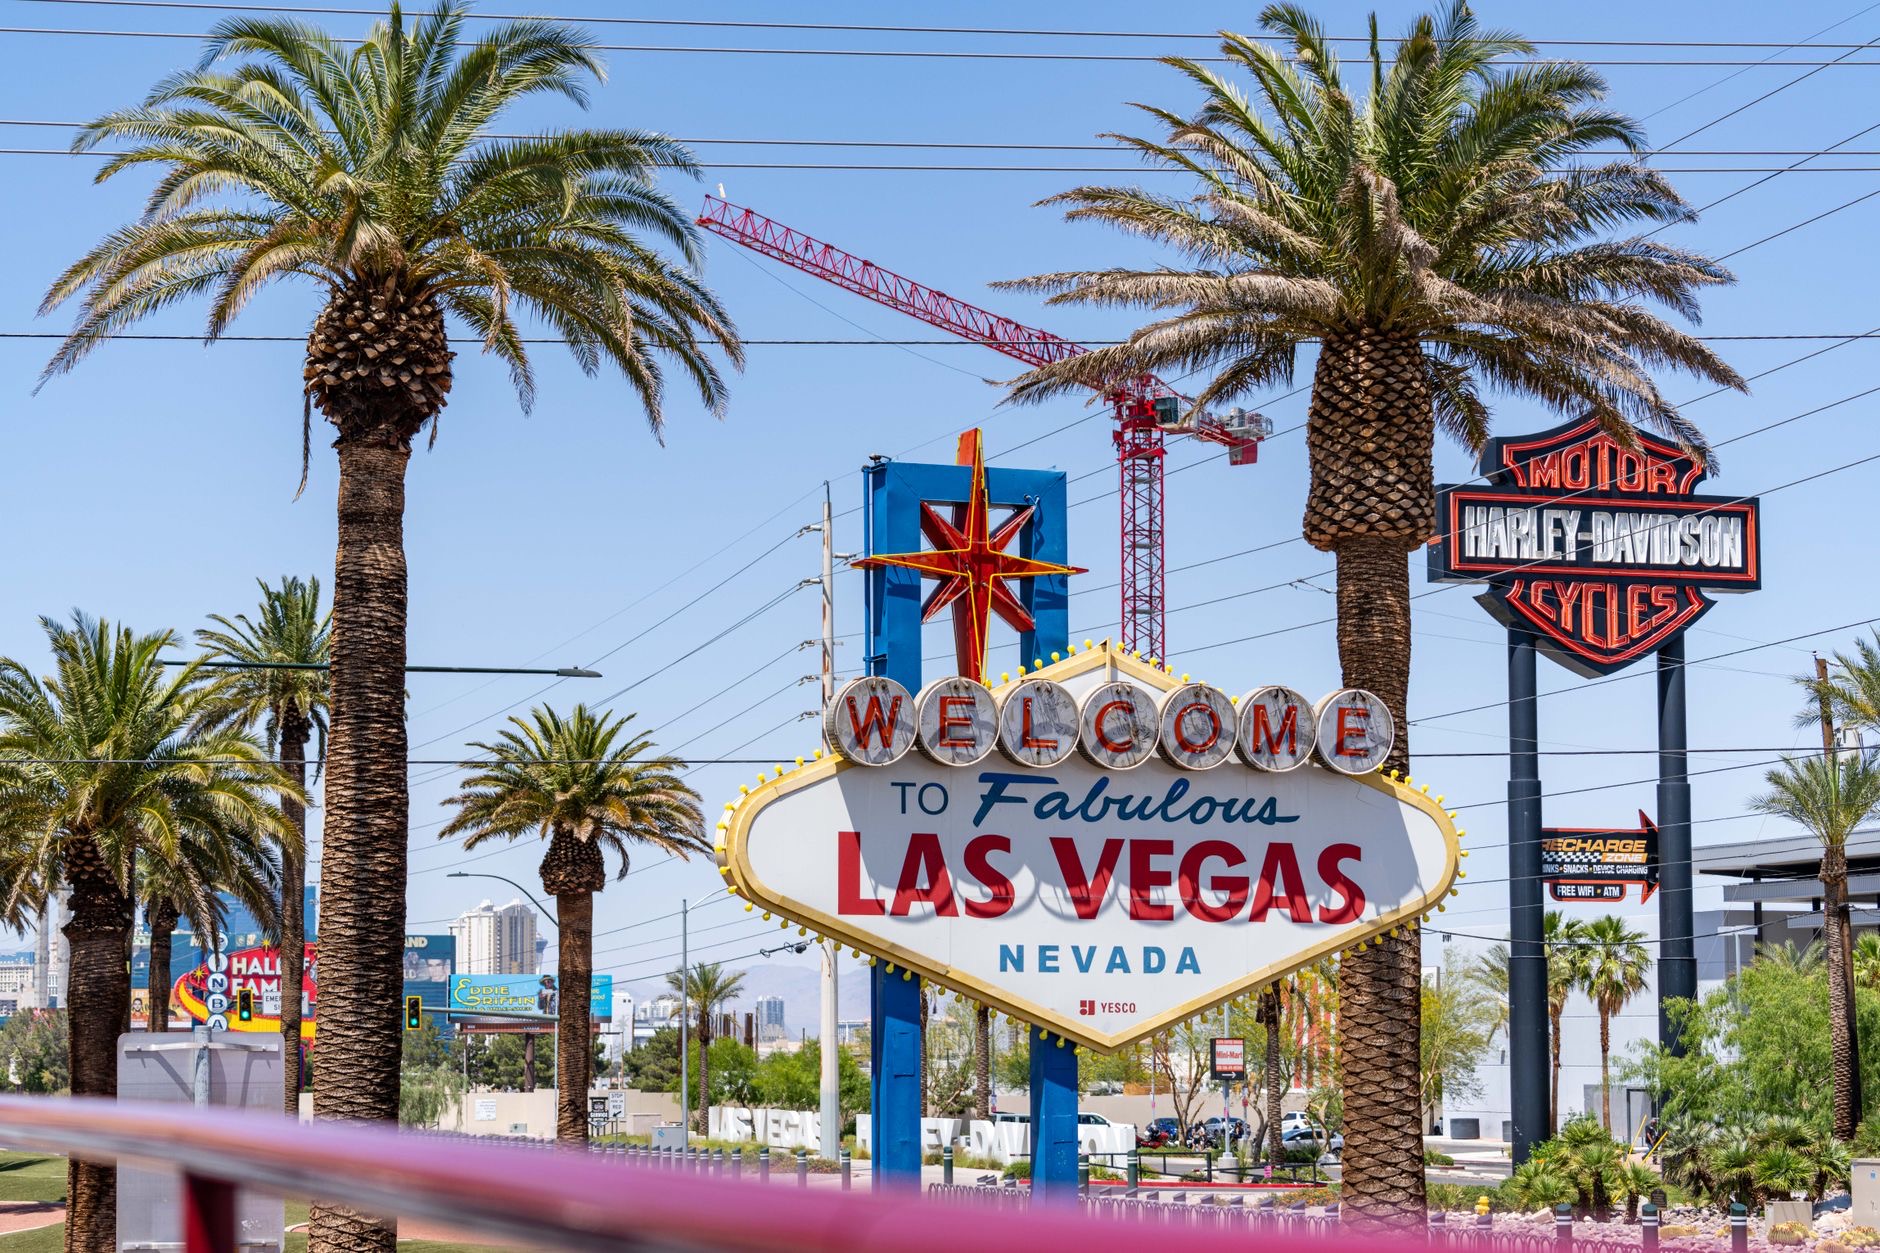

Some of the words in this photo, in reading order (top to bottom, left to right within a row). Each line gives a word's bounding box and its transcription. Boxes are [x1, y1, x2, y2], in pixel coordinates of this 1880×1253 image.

[1529, 433, 1678, 494] MOTOR
[1464, 505, 1742, 568] HARLEY-DAVIDSON
[1530, 580, 1678, 649] CYCLES
[845, 695, 1371, 758] WELCOME
[891, 781, 949, 816] TO
[972, 772, 1300, 828] Fabulous
[1542, 838, 1647, 853] RECHARGE
[1606, 853, 1644, 862] ZONE
[838, 831, 1016, 919] LAS
[1050, 836, 1366, 925] VEGAS
[1563, 864, 1589, 874] SNACKS
[1593, 865, 1615, 874] DEVICE
[1616, 865, 1648, 875] CHARGING
[1557, 885, 1576, 897] FREE
[1578, 885, 1595, 897] WIFI
[1603, 886, 1620, 897] ATM
[1000, 944, 1202, 975] NEVADA
[454, 978, 510, 999] EDDIE
[466, 996, 535, 1006] GRIFFIN
[708, 1106, 752, 1142] LAS
